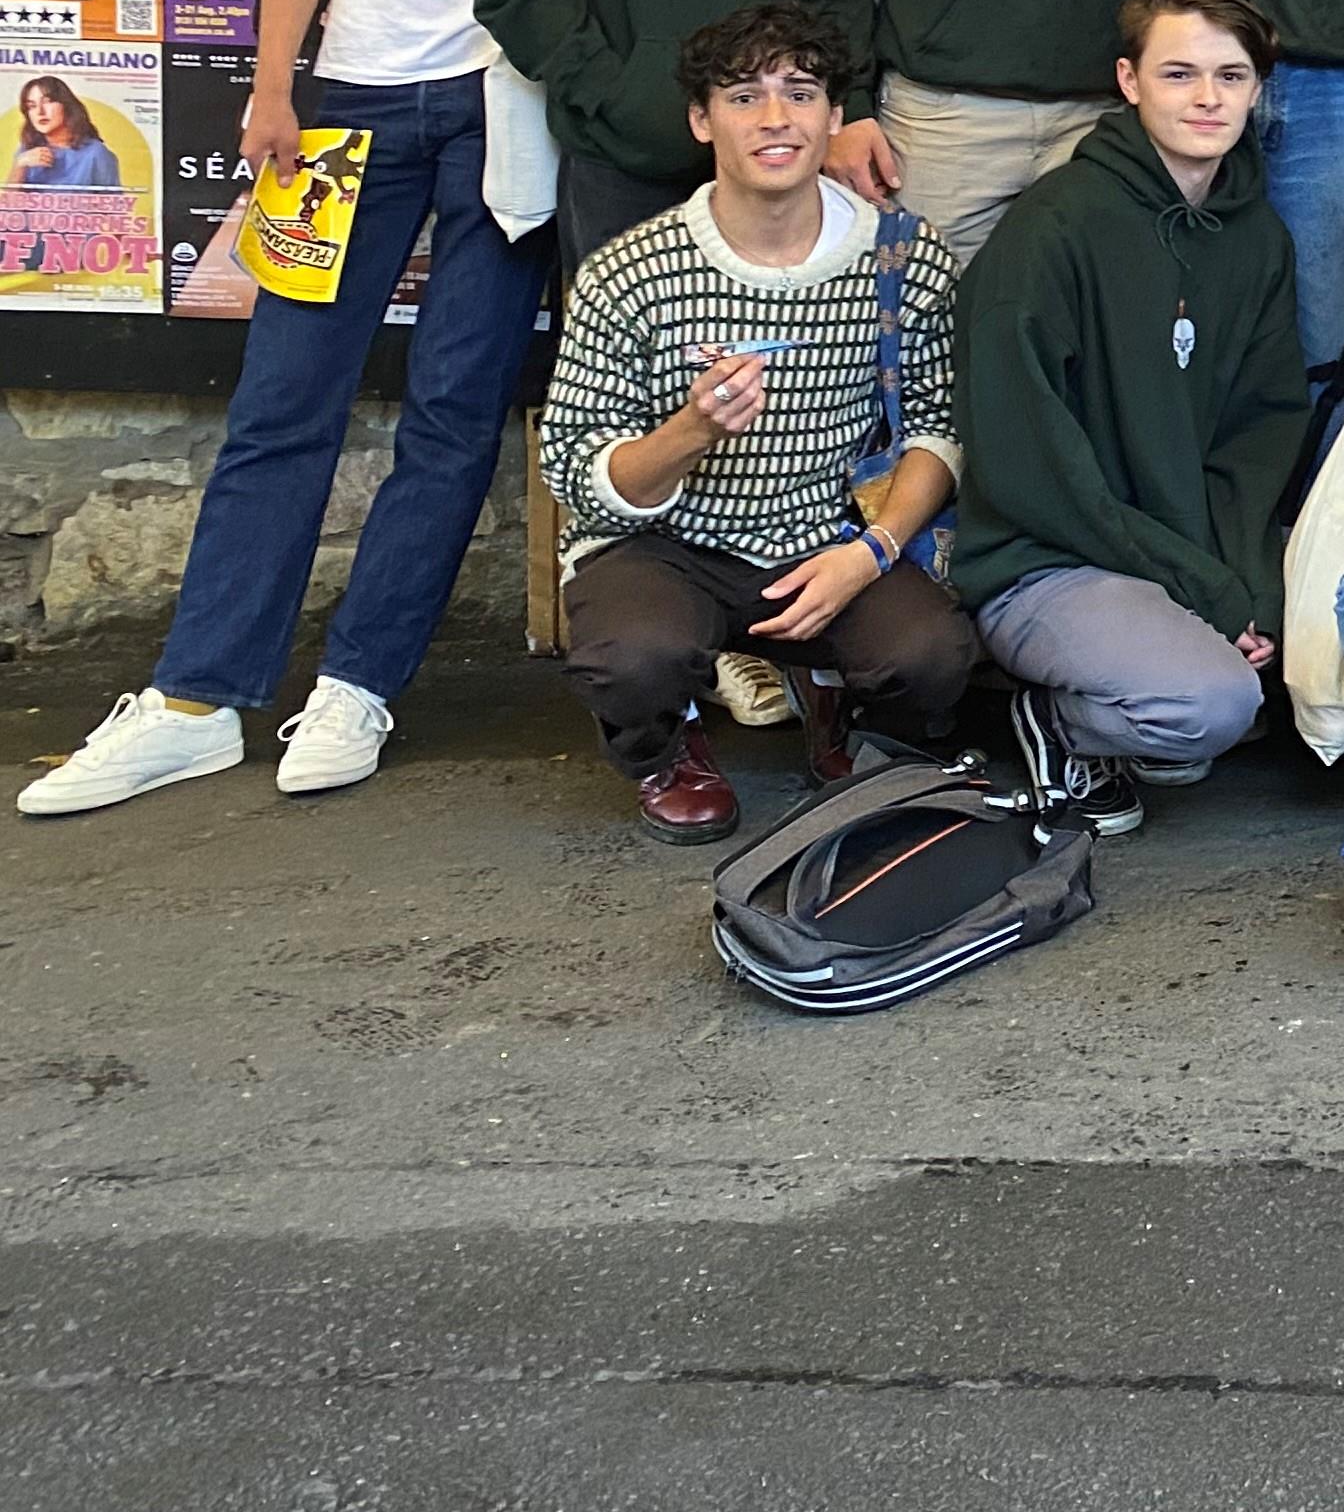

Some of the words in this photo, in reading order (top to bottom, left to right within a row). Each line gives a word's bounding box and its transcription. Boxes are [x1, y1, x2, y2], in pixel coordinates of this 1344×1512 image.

[0, 48, 29, 66] IA
[32, 49, 158, 70] MAGLIANO
[178, 151, 255, 181] SÉA
[28, 212, 148, 234] WORRIES
[0, 234, 38, 273] F
[39, 234, 158, 276] NOT
